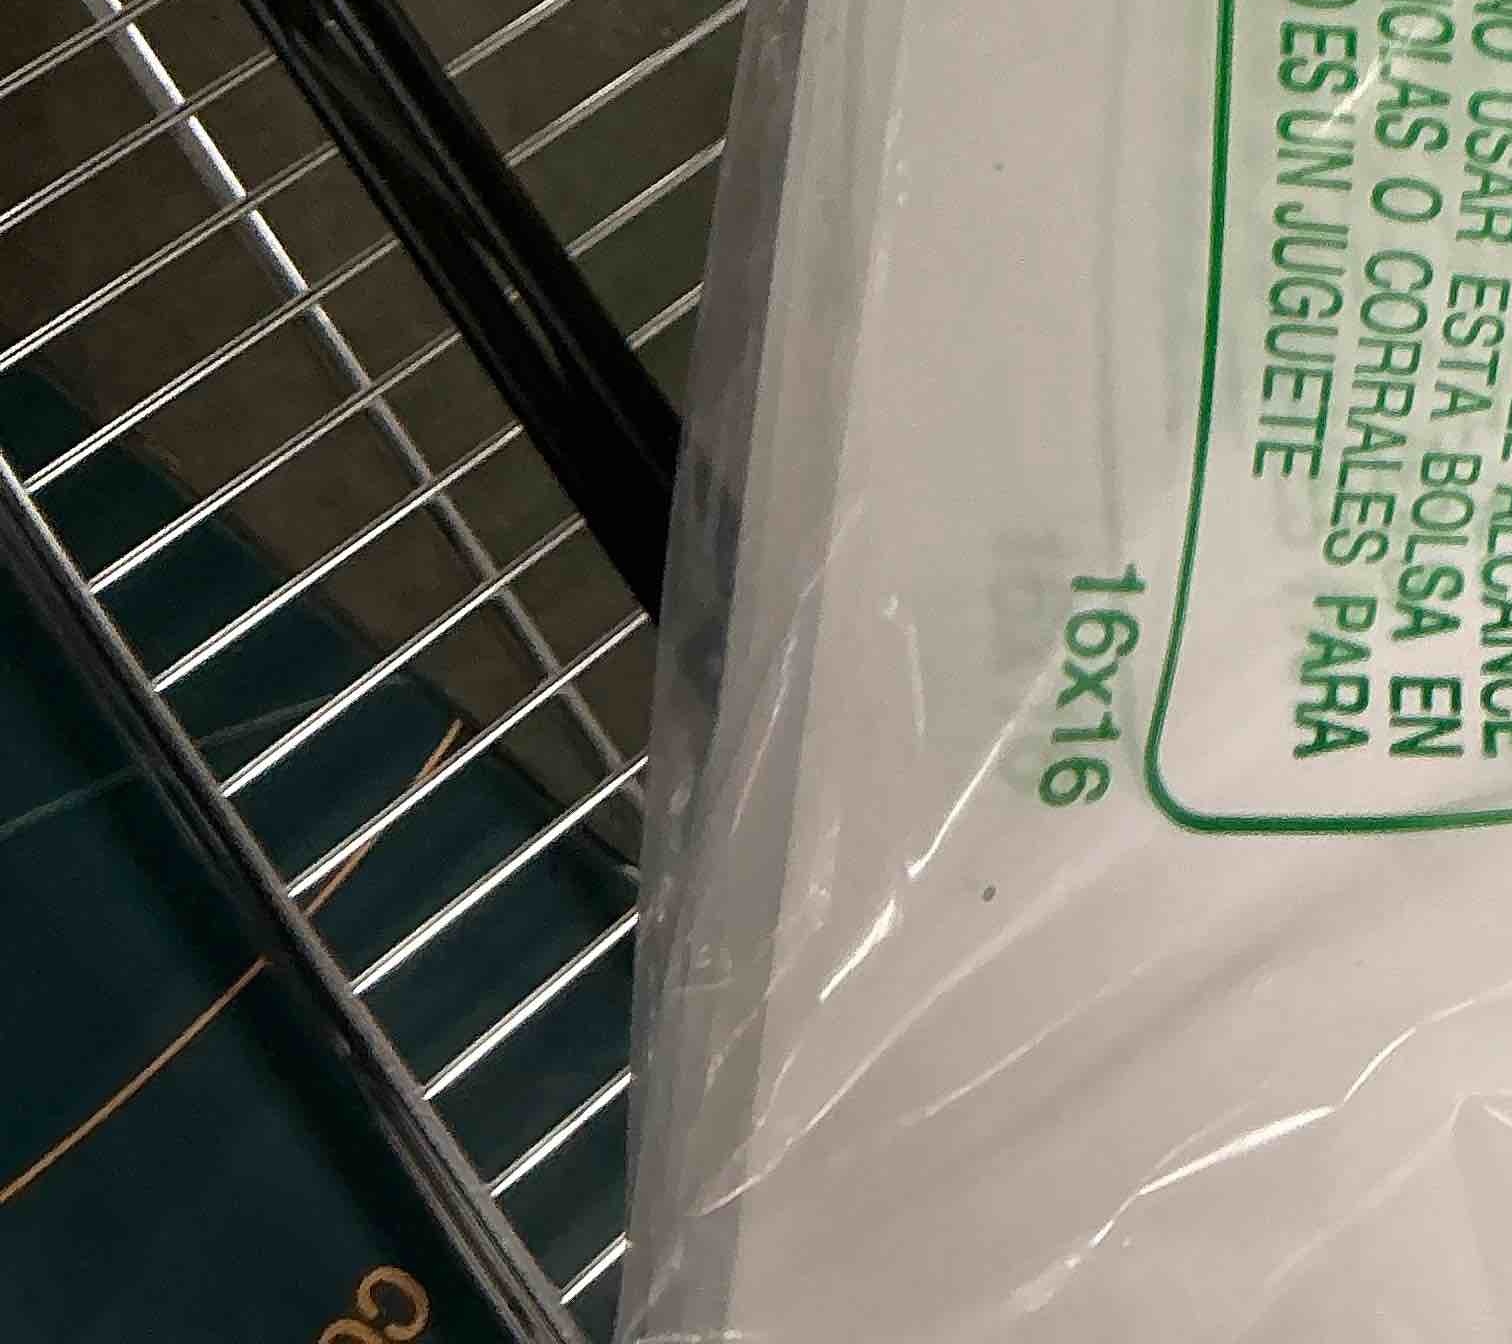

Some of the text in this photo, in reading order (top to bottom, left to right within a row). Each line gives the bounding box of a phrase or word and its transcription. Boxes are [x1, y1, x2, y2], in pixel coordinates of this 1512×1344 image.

[1276, 21, 1358, 94] ES
[1273, 110, 1355, 190] UN
[1370, 178, 1443, 223] O
[1253, 202, 1349, 479] JUGUETE
[1322, 251, 1434, 564] CORRALES
[1430, 273, 1510, 419] ESTA
[1390, 452, 1482, 640] BOLSA
[1038, 563, 1147, 807] 16x16
[1292, 595, 1378, 759] PARA
[1387, 675, 1462, 757] EN
